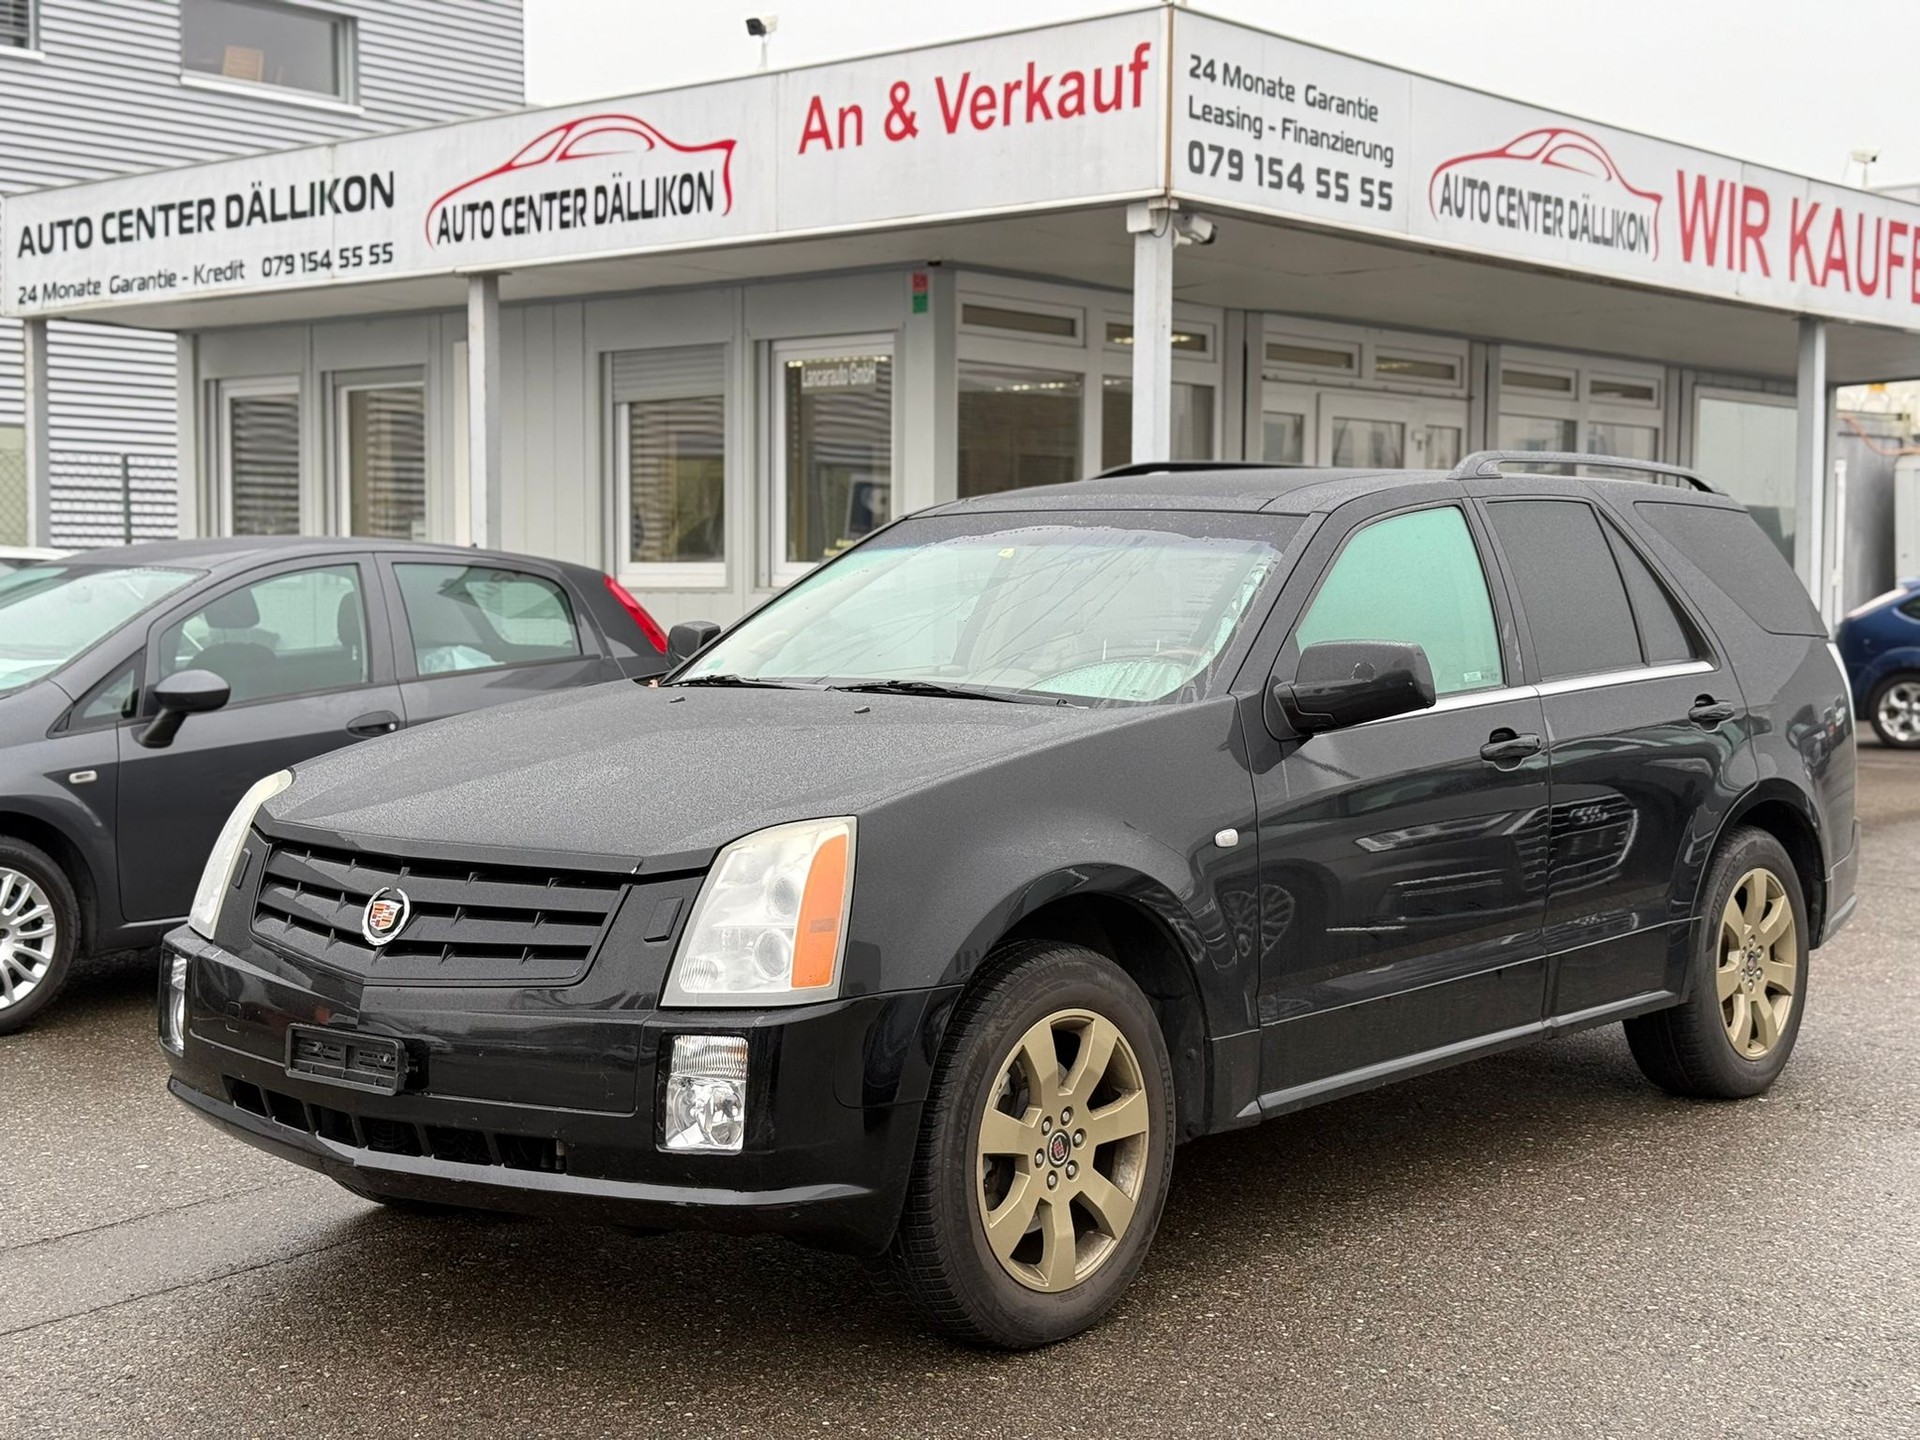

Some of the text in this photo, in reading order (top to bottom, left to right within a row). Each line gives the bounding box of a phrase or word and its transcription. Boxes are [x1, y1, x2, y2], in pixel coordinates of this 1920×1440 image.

[798, 42, 1151, 154] An & Verkauf
[1190, 54, 1378, 122] 24 Monate Garantie
[1189, 95, 1262, 140] Leasing
[1282, 118, 1393, 168] Finanzierung
[437, 171, 713, 244] AUTO CENTER DÄLLIKON
[1188, 140, 1392, 211] 079 154 55 55
[18, 171, 393, 258] AUTO CENTER DÄLLIKON
[1440, 172, 1650, 253] AUTO CENTER DÄLLIKON
[1677, 169, 1771, 278] WIR
[18, 285, 37, 305] 24
[43, 279, 101, 301] Monate
[110, 271, 176, 294] Garantie
[194, 261, 244, 284] Kredit
[262, 254, 294, 277] 079
[301, 250, 332, 272] 154
[339, 246, 362, 268] 55
[369, 242, 393, 265] 55
